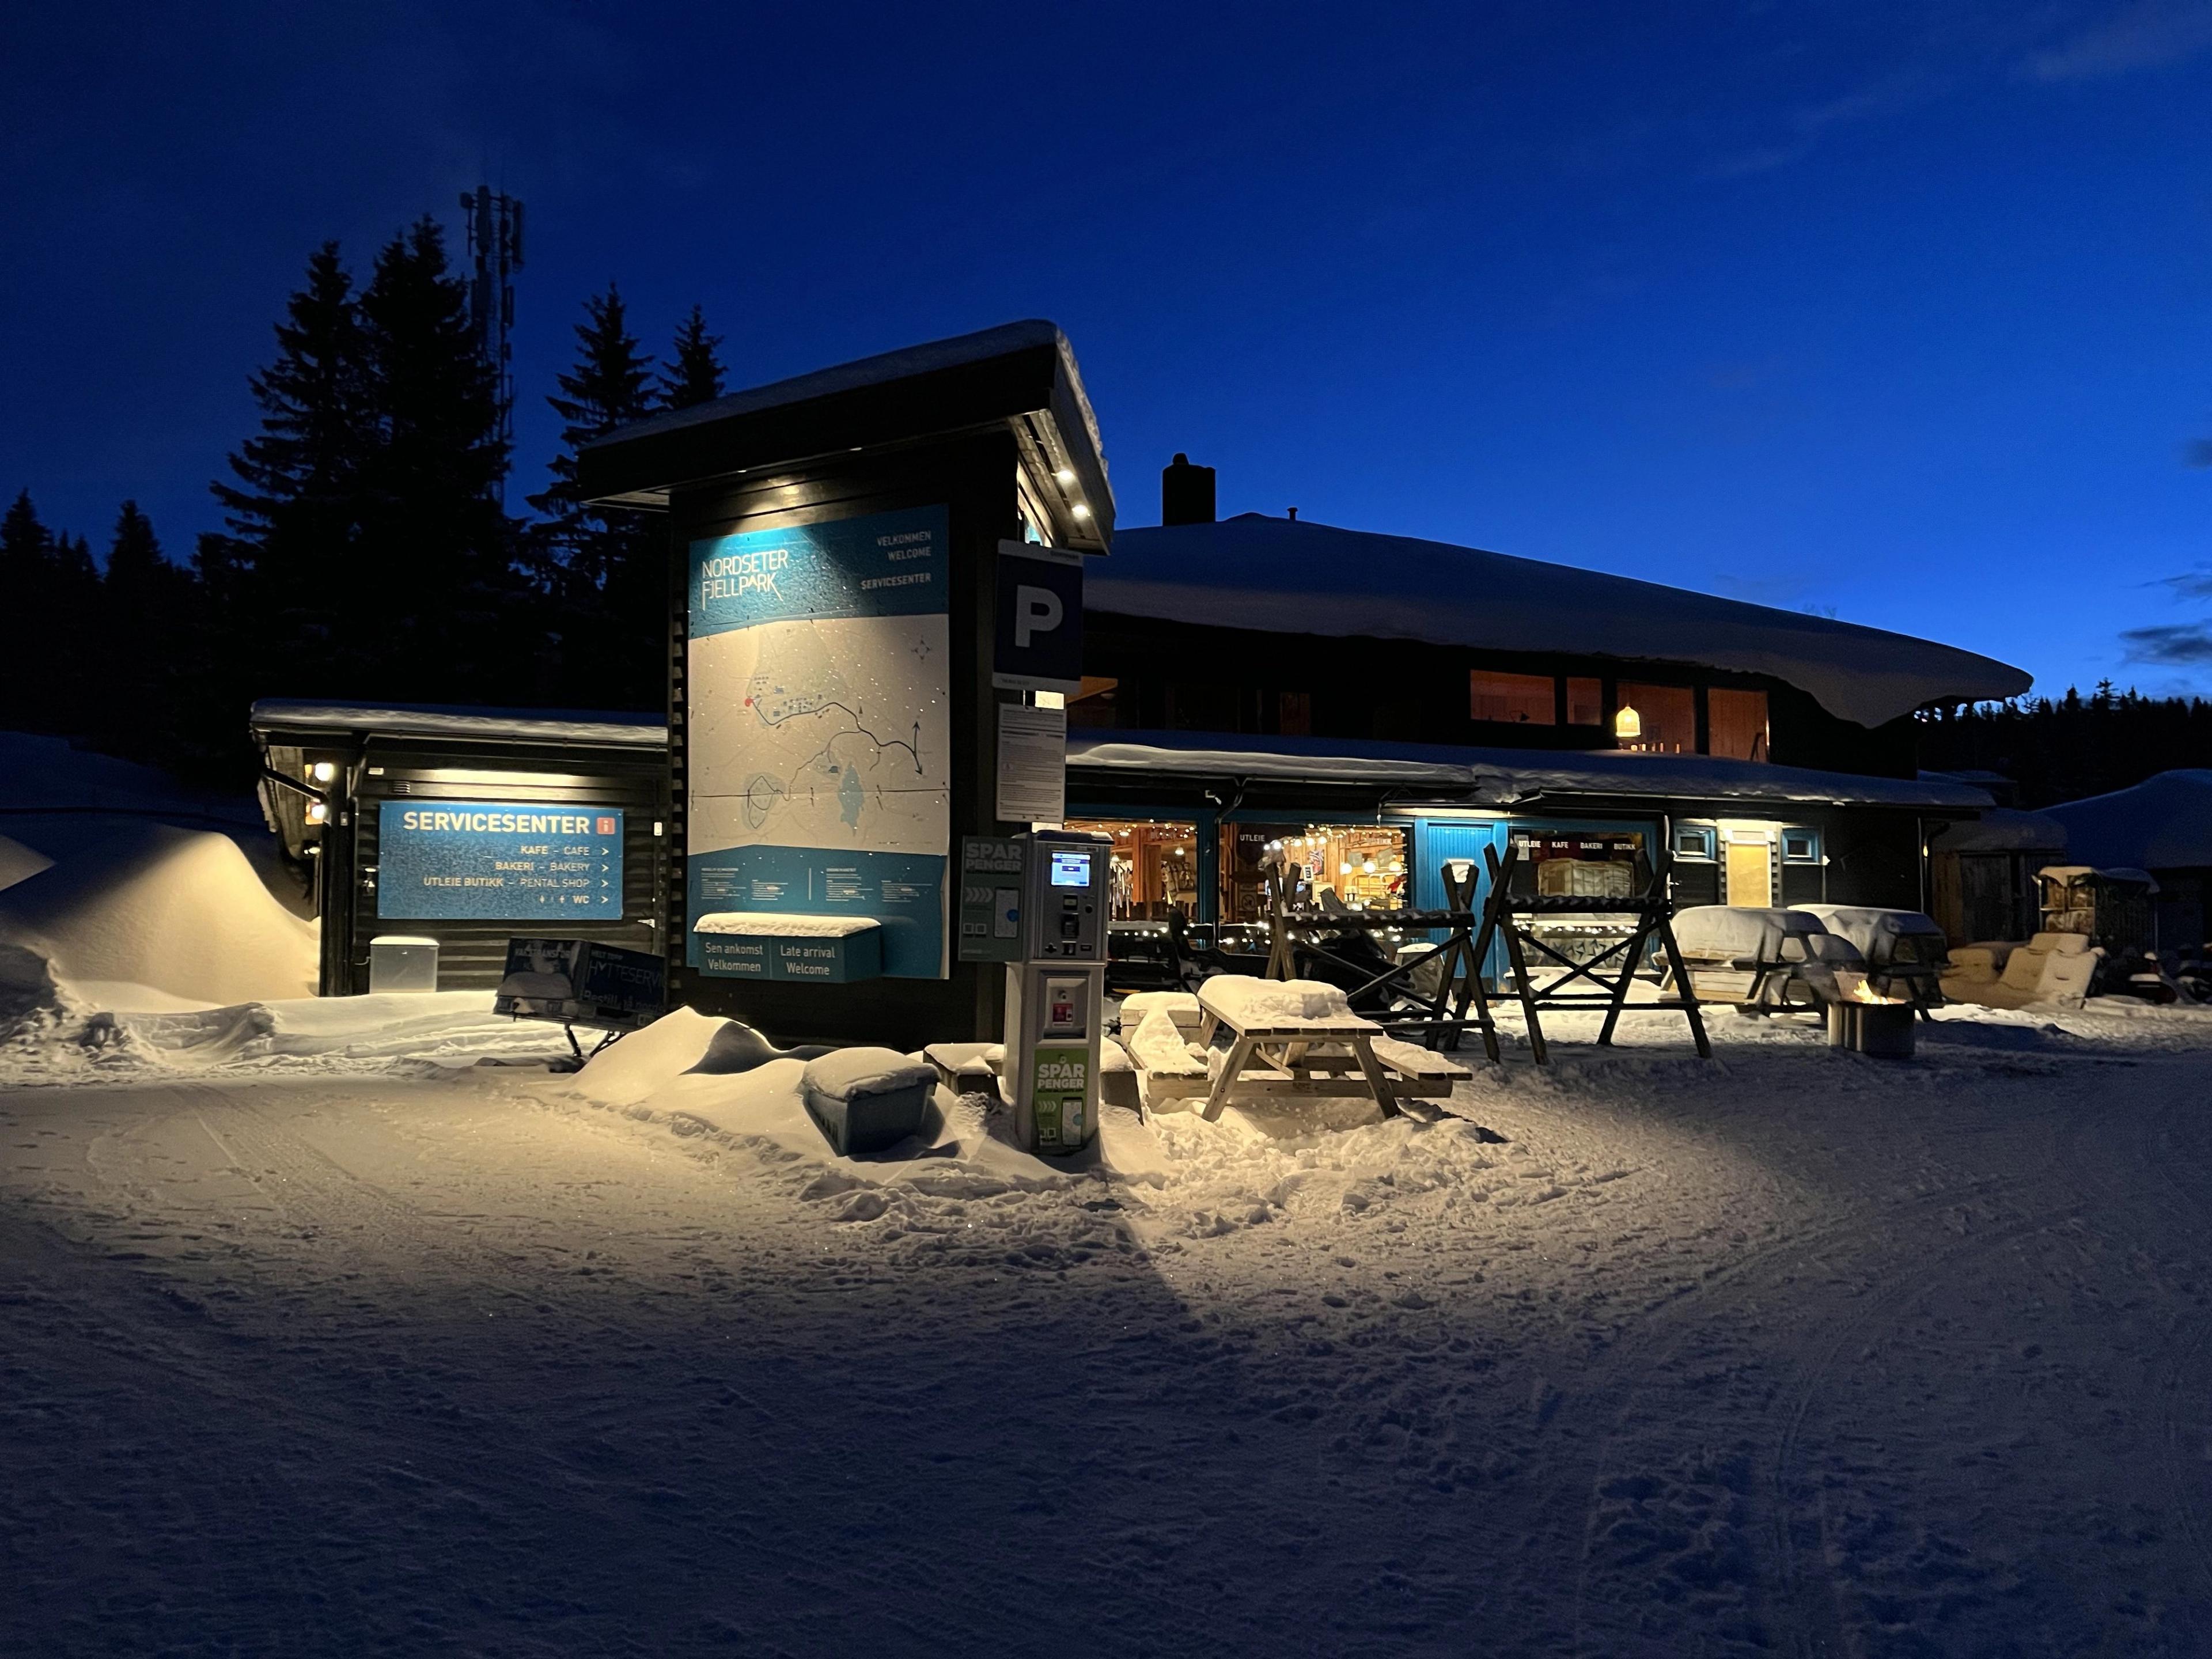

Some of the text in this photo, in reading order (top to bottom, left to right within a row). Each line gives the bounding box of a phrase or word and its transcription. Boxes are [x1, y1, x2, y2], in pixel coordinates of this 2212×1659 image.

[877, 531, 931, 547] VELKOMMEN
[888, 547, 931, 561] WELCOME
[702, 550, 788, 577] NORDSETER
[861, 573, 931, 590] SERVICESENTER
[702, 573, 783, 611] FJELLPARK
[1015, 585, 1063, 648] P
[403, 812, 590, 834] SERVICESENTER
[1240, 834, 1266, 842] UTLEIE
[1518, 840, 1541, 848] UTLEIE
[521, 846, 548, 855] KAFE
[563, 846, 590, 856] CAFE
[966, 842, 1022, 859] SPAR
[495, 862, 534, 872] BAKERI
[550, 862, 590, 872] BAKERY
[965, 858, 1022, 870] PENGER
[423, 877, 461, 887] UTLEIE
[464, 877, 503, 887] BUTIKK
[520, 878, 560, 888] RENTAL
[562, 878, 590, 888] SHOP
[573, 895, 589, 904] WC
[706, 942, 764, 956] Sen ankomst
[780, 945, 836, 959] Late arrival
[708, 959, 761, 972] Velkommen
[786, 961, 830, 975] Welcome
[1038, 1063, 1085, 1078] SPAR
[1037, 1078, 1084, 1089] PENGER
